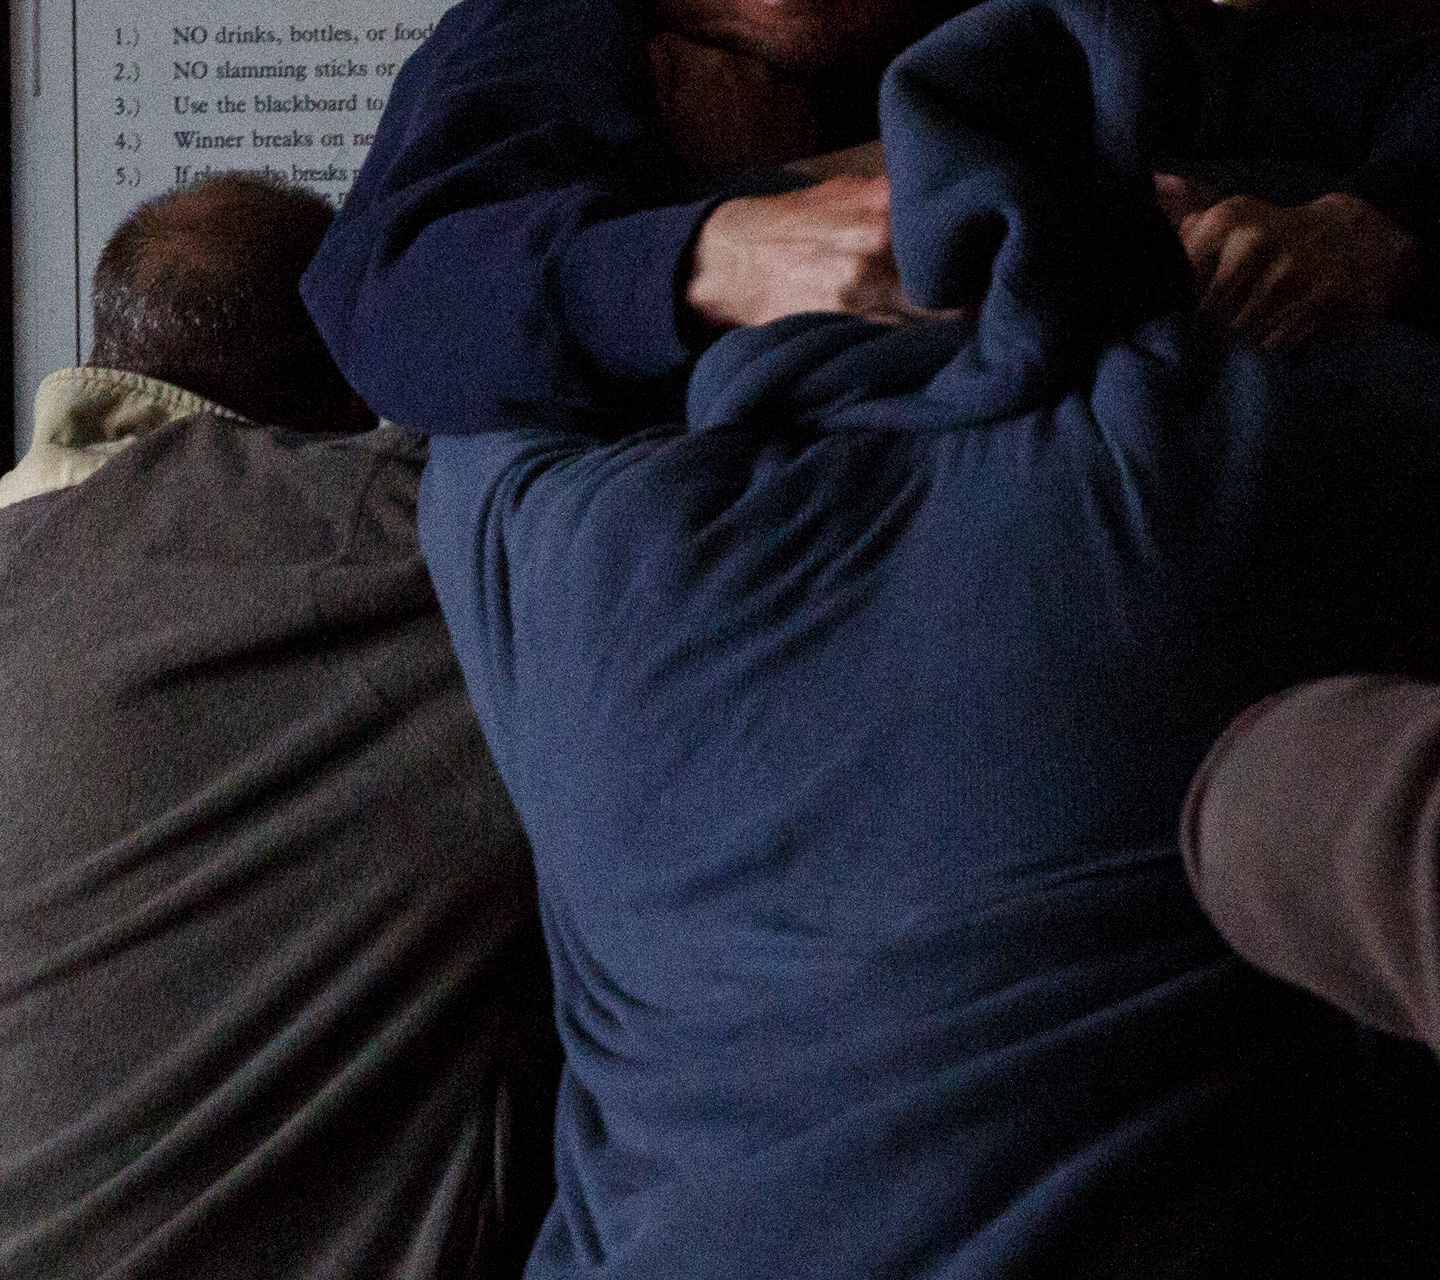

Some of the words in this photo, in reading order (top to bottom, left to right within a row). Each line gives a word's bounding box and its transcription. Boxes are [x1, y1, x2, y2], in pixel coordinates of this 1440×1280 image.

[115, 27, 141, 48] 1.)
[173, 26, 208, 45] NO
[214, 25, 284, 47] drinks,
[289, 24, 360, 45] bottles,
[366, 28, 388, 42] or
[114, 61, 141, 82] 2.)
[173, 61, 208, 80] NO
[216, 60, 307, 83] slamming
[314, 58, 369, 78] sticks
[375, 63, 394, 78] or
[114, 96, 141, 118] 3.)
[173, 95, 208, 114] Use
[216, 94, 247, 114] the
[253, 93, 358, 113] blackboard
[366, 95, 384, 112] to
[114, 131, 142, 151] 4.)
[173, 129, 244, 149] Winner
[251, 128, 313, 148] breaks
[320, 133, 345, 148] on
[290, 165, 349, 183] breaks
